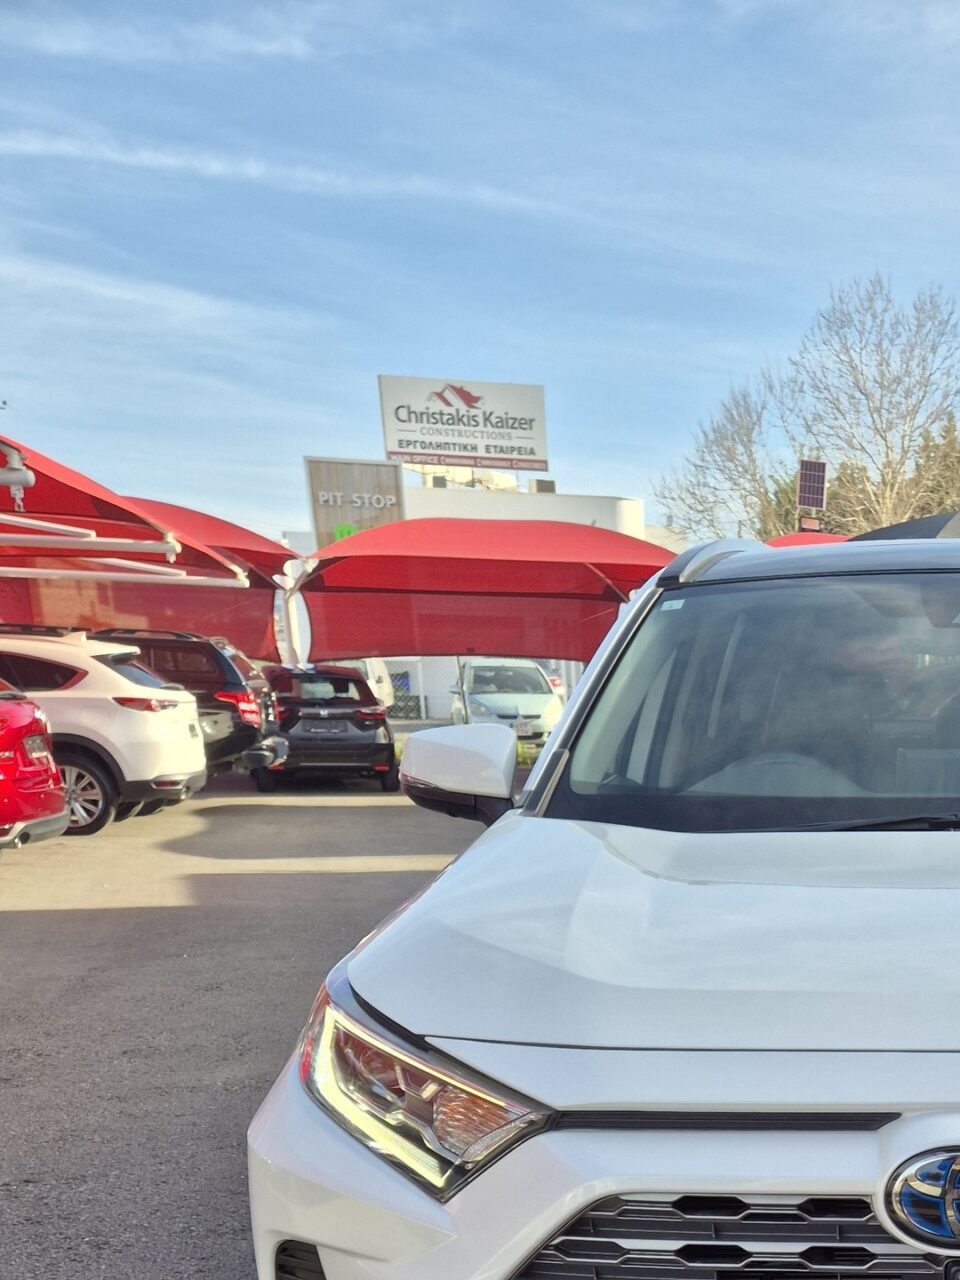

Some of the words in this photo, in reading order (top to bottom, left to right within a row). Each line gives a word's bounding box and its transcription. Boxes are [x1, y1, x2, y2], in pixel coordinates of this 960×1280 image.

[394, 404, 480, 428] Christakis
[483, 410, 536, 431] Kaizer
[419, 427, 513, 441] CONSTRUCTIONS
[485, 444, 536, 456] ΕΤΑΙΡΕΙΑ
[319, 491, 344, 506] PIT
[352, 493, 396, 508] STOP
